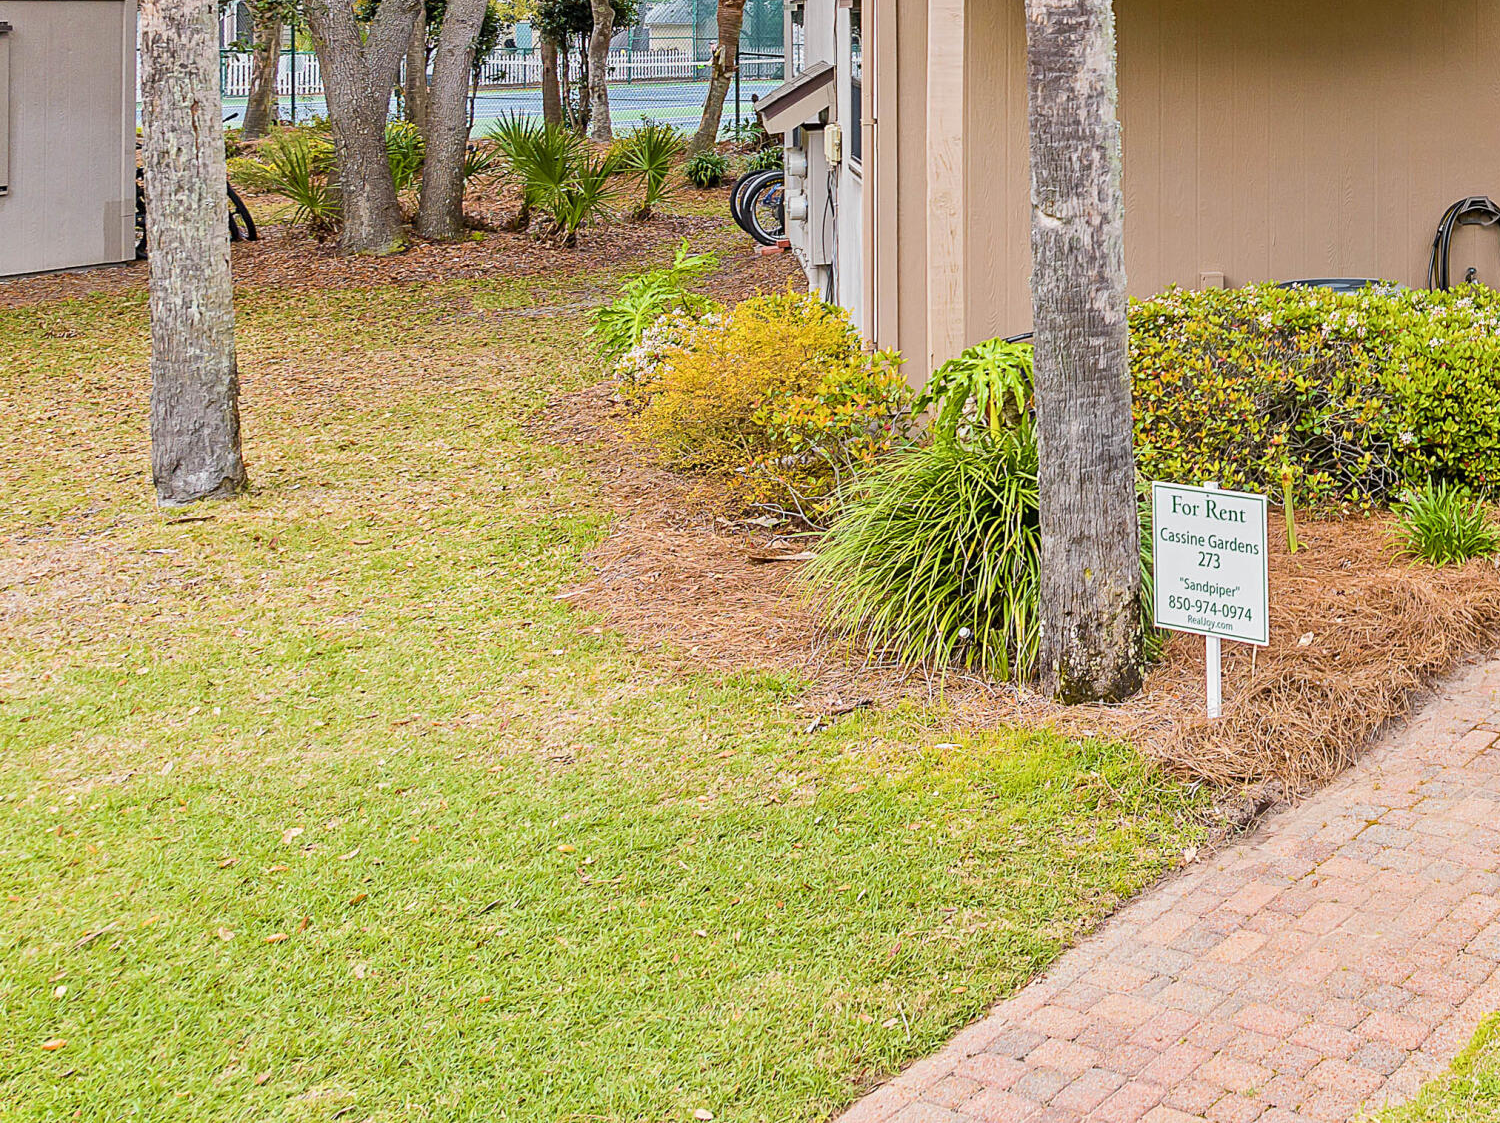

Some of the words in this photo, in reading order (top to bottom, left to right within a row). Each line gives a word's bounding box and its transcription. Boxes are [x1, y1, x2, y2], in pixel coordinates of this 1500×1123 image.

[1171, 494, 1200, 517] For
[1205, 499, 1247, 523] Rent
[1160, 527, 1205, 547] Cassine
[1208, 534, 1260, 555] Gardens
[1198, 551, 1221, 569] 273
[1179, 576, 1240, 598] "Sandpiper"
[1168, 594, 1252, 622] 850-974-0974
[1187, 614, 1233, 631] RealJoy.com
